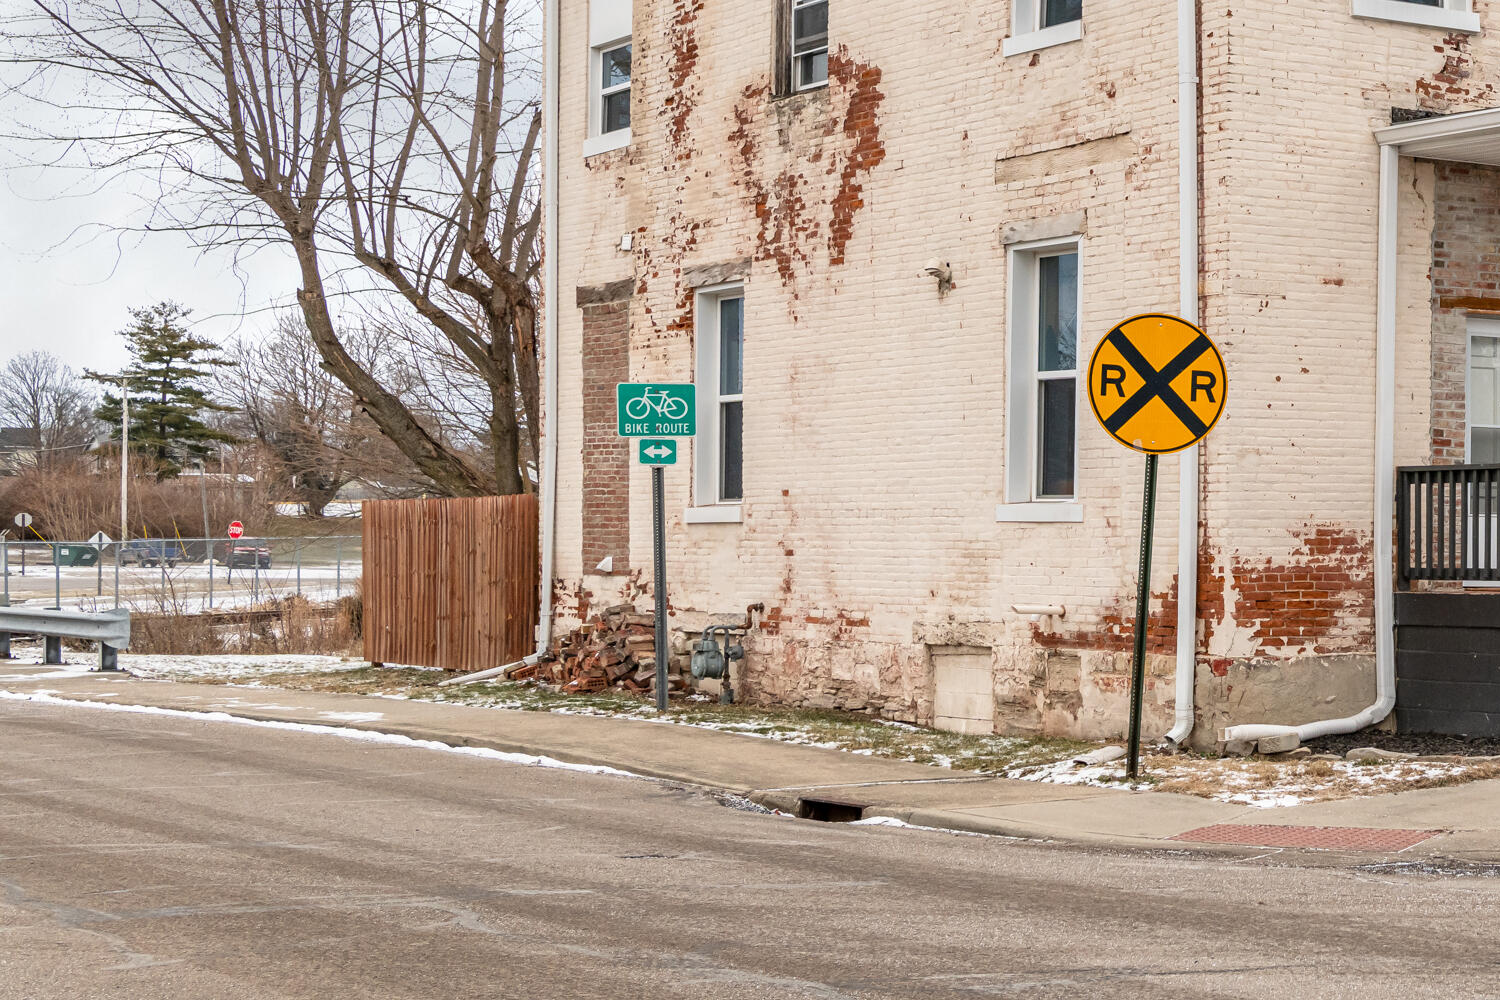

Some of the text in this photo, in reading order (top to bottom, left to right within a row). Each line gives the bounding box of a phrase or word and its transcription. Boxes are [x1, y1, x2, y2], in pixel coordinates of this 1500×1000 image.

[624, 423, 690, 434] BIKE ROUTE
[229, 526, 243, 534] STOP
